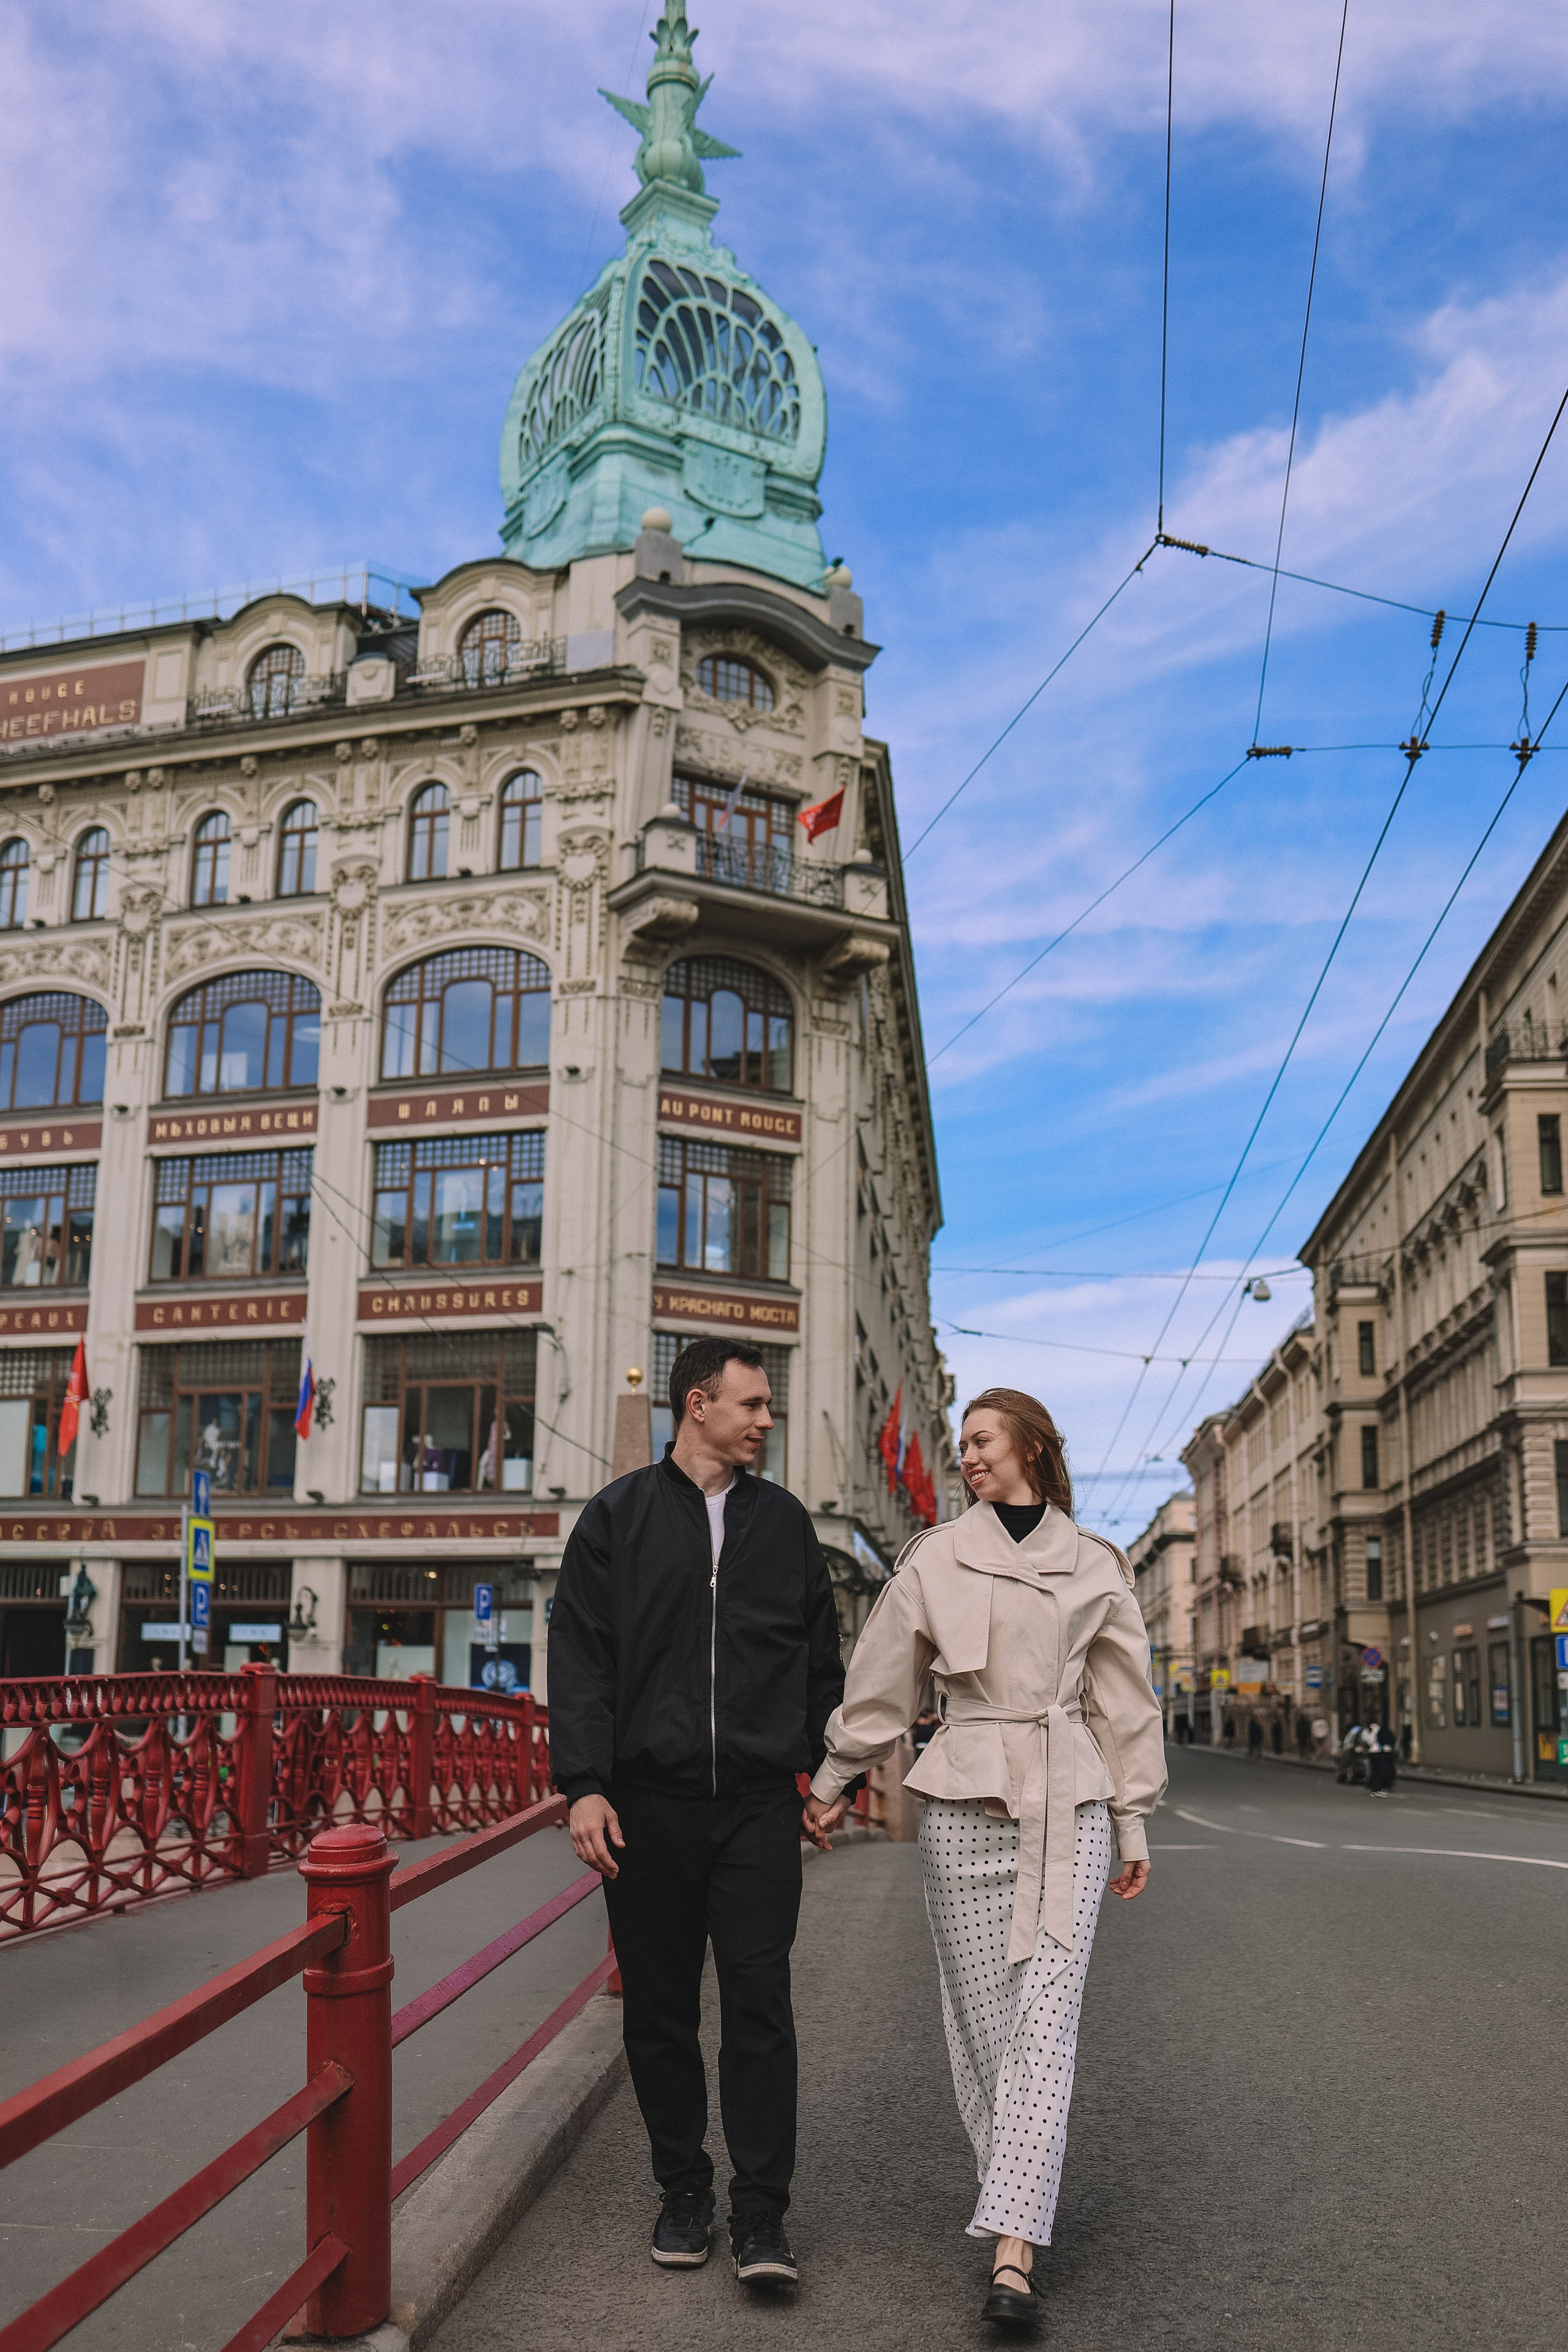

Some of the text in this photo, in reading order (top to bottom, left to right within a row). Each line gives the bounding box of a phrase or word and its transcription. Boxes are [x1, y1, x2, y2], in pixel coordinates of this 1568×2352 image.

[399, 1093, 519, 1119] ШЛЯПЫ
[661, 1098, 796, 1135] AU PONT ROUGE
[372, 1289, 530, 1313] CHAUSSURES
